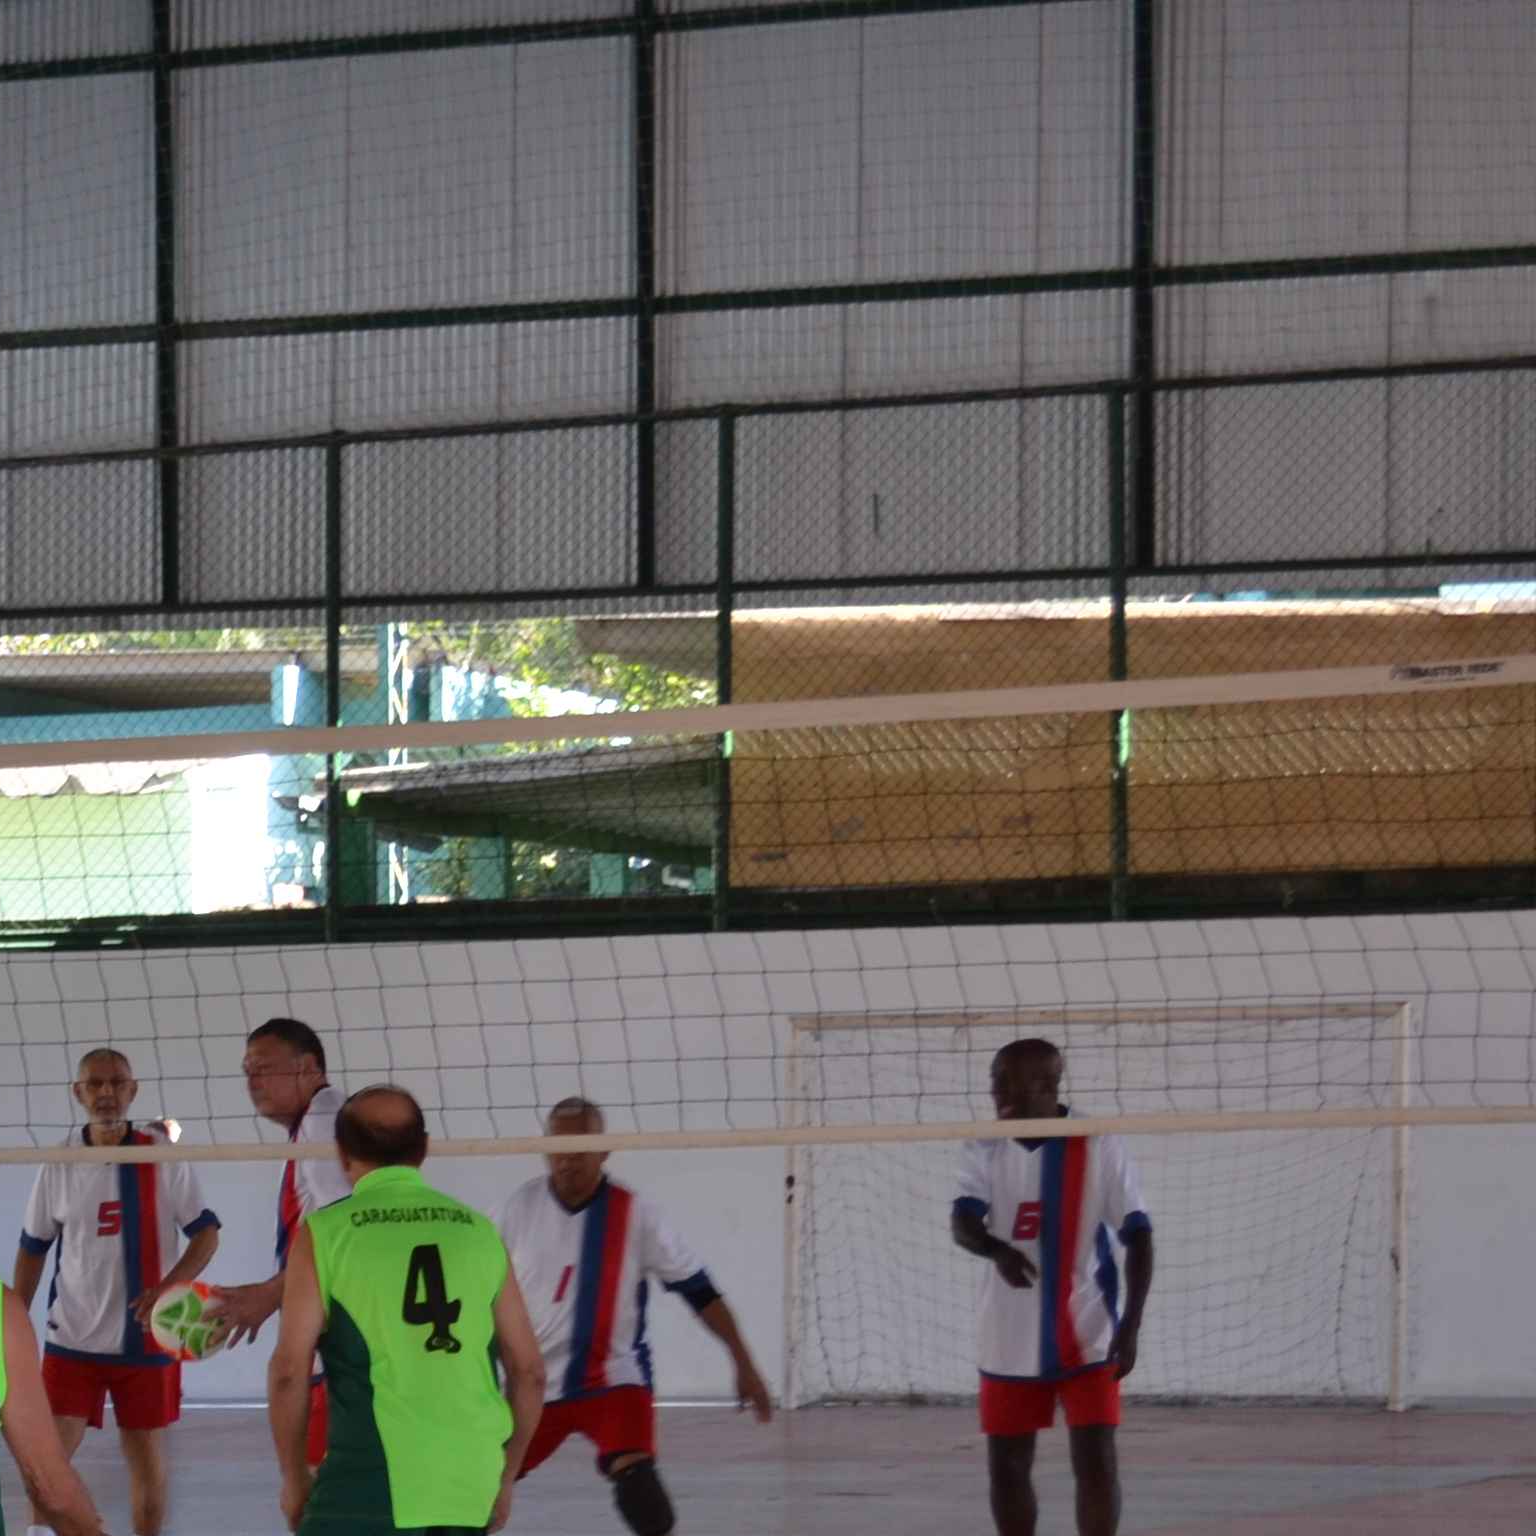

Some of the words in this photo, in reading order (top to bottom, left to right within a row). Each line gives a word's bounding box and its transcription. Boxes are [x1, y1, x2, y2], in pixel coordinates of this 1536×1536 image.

[97, 1202, 122, 1237] 5
[351, 1207, 475, 1227] CARAGUATATUBA
[1012, 1202, 1042, 1240] 6
[402, 1244, 462, 1354] 4
